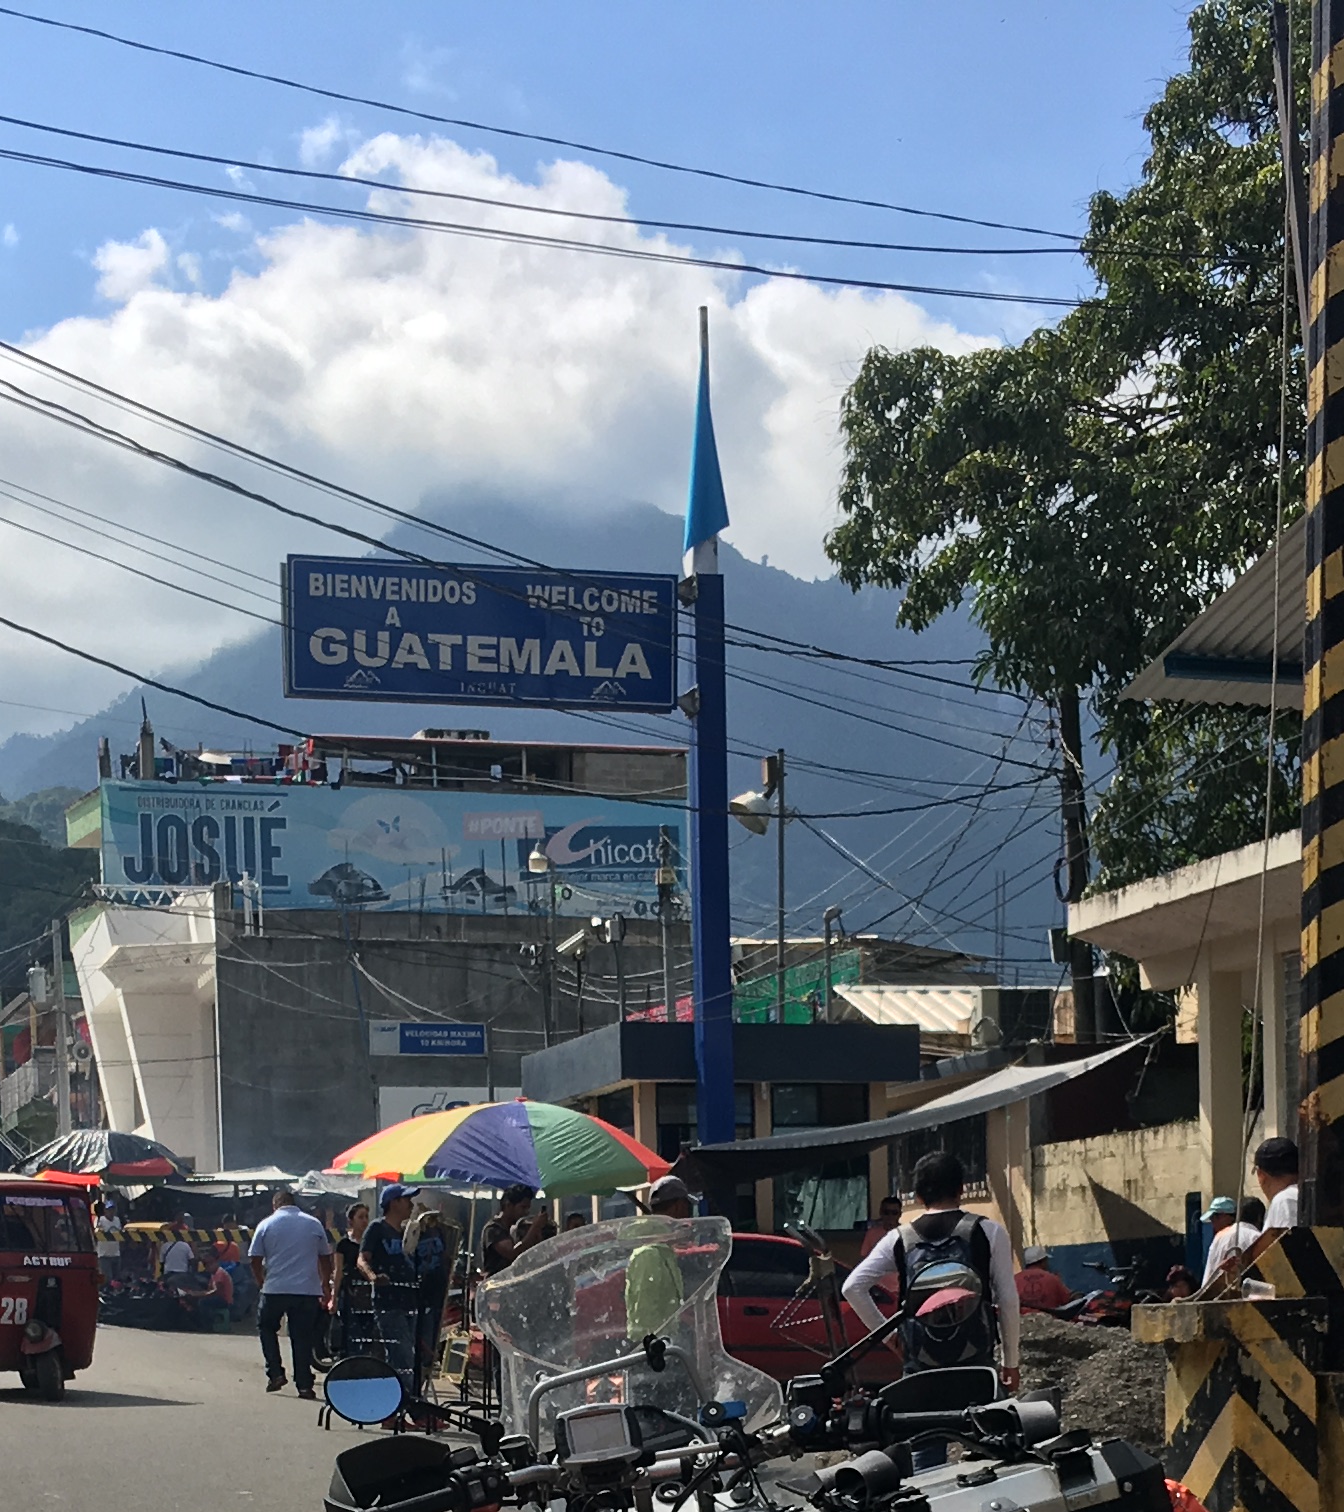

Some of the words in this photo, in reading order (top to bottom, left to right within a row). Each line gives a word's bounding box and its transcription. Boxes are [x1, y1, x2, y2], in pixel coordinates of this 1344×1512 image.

[309, 573, 476, 604] BIENVENIDOS
[526, 584, 658, 614] WELCOME
[385, 607, 401, 628] A
[578, 616, 606, 637] TO
[309, 627, 652, 680] GUATEMALA
[460, 682, 516, 694] INGUAT
[137, 795, 200, 810] DISTRIBUIDORA
[206, 798, 216, 810] DE
[220, 798, 265, 812] CHANCLAS
[468, 815, 537, 835] #PONTE
[123, 800, 289, 887] JOSUÉ
[0, 1297, 28, 1325] 28
